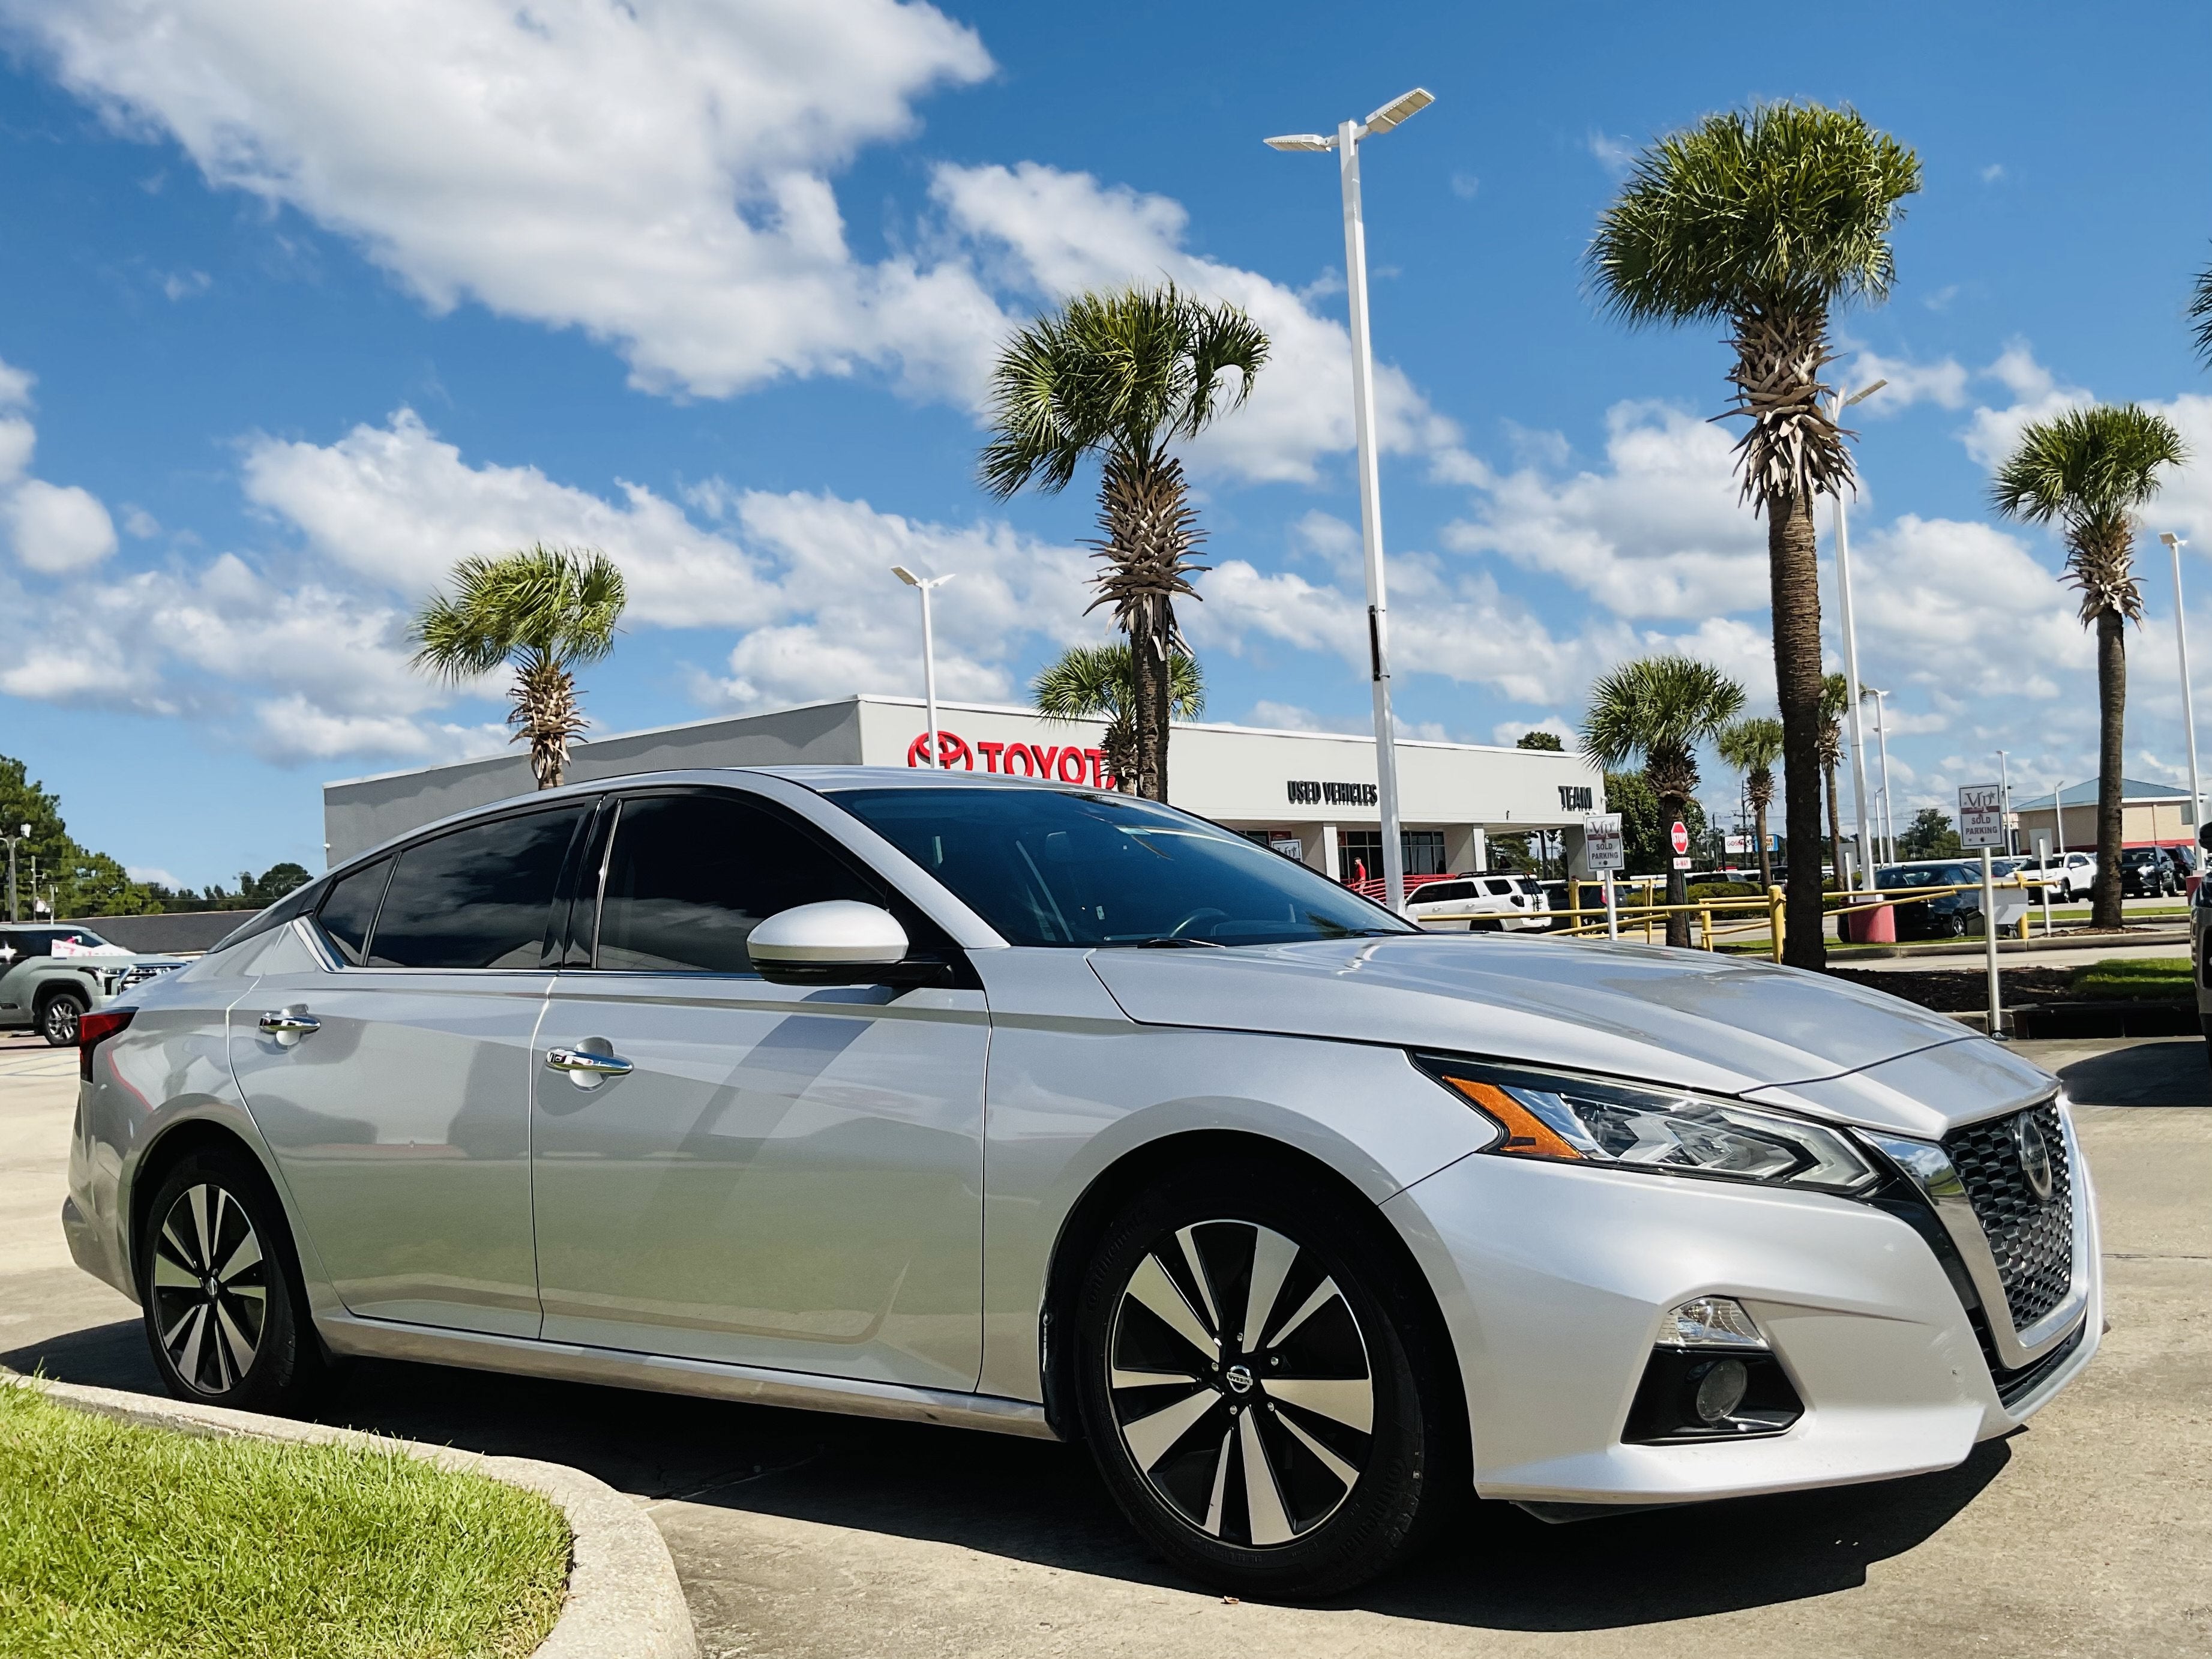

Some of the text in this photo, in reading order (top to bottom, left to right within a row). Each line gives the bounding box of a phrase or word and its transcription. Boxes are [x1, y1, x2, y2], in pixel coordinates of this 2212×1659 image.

[978, 742, 1116, 789] TOYOT
[1287, 781, 1377, 805] USED VEHICLES
[1558, 786, 1592, 811] TEAM
[1673, 833, 1686, 843] STOP
